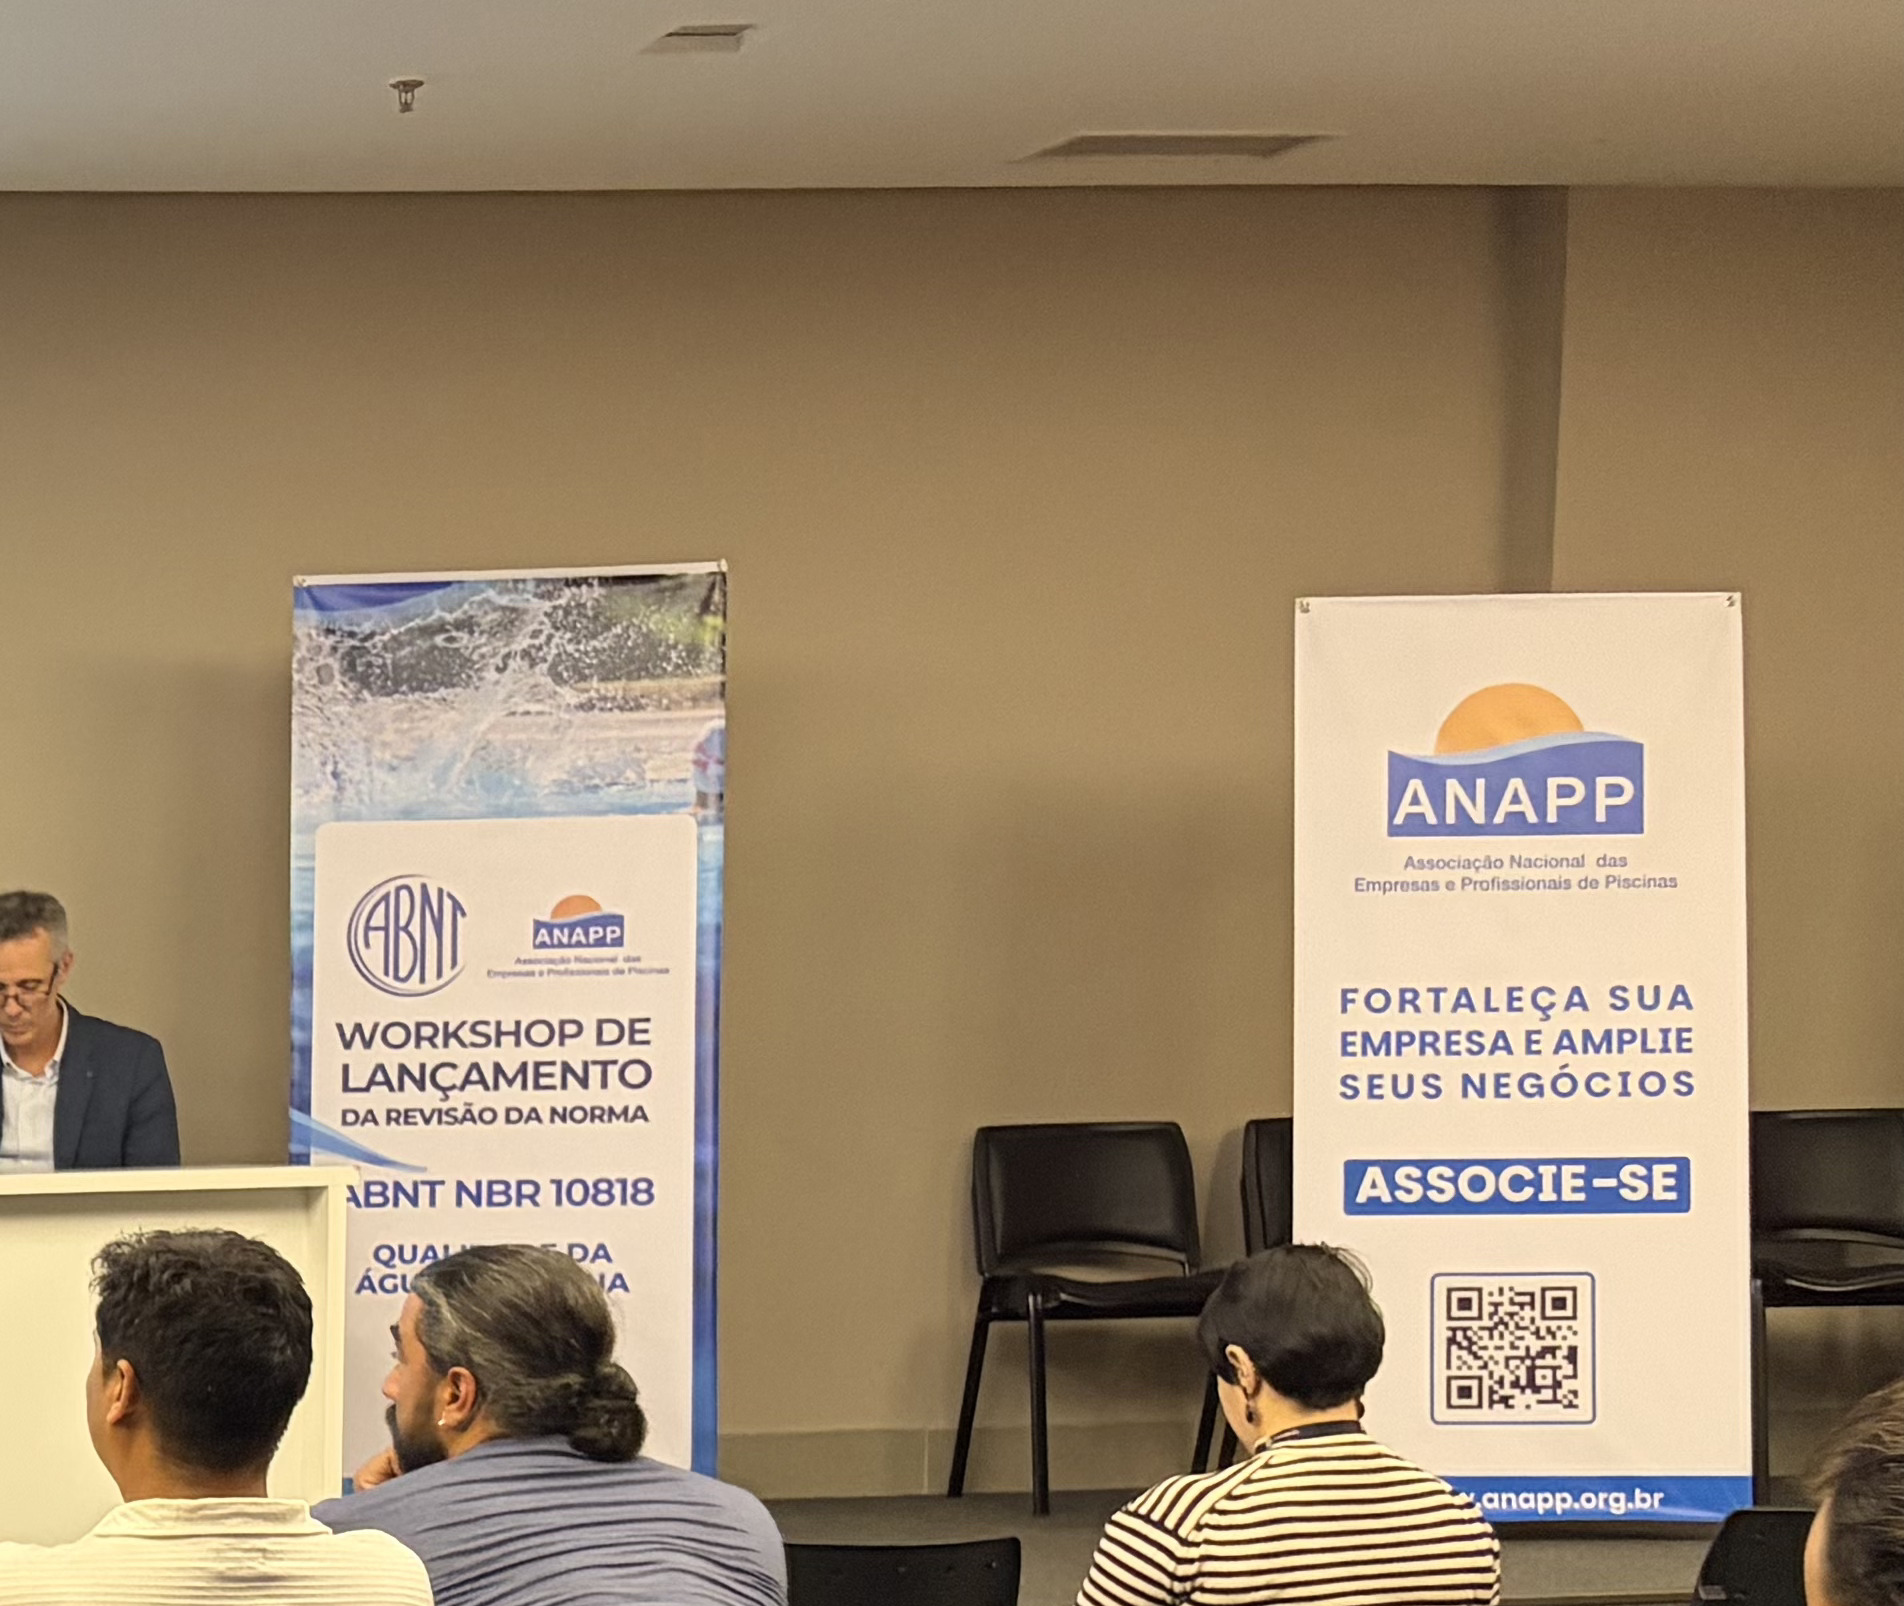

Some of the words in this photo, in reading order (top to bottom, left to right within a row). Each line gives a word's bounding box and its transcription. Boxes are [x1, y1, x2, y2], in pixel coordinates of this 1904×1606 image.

[1393, 776, 1635, 825] ANAPP
[1403, 855, 1504, 873] Associação
[1509, 853, 1585, 869] Nacional
[1596, 853, 1628, 868] das
[1354, 877, 1440, 896] Empresas
[1445, 880, 1456, 892] e
[1461, 875, 1572, 892] Profissionais
[1577, 875, 1600, 890] de
[1605, 874, 1678, 889] Piscinas
[364, 882, 467, 984] ABNT
[535, 926, 621, 946] ANAPP
[1341, 986, 1590, 1022] FORTALEÇA
[1609, 984, 1694, 1011] SUA
[335, 1019, 584, 1050] WORKSHOP
[596, 1017, 651, 1046] DE
[1341, 1030, 1514, 1057] EMPRESA
[1525, 1029, 1542, 1055] E
[1552, 1027, 1693, 1055] AMPLIE
[342, 1059, 652, 1102] LANÇAMENTO
[1339, 1073, 1442, 1100] SEUS
[1461, 1063, 1694, 1099] NEGÓCIOS
[341, 1108, 380, 1127] DA
[385, 1102, 498, 1126] REVISÃO
[505, 1106, 543, 1125] DA
[549, 1105, 650, 1124] NORMA
[455, 1179, 541, 1208] NBR
[549, 1177, 655, 1207] 10818
[1355, 1163, 1678, 1203] ASSOCIE-SE
[567, 1243, 613, 1263] DA
[355, 1268, 411, 1294] ÁG
[1471, 1488, 1665, 1515] .anapp.org.br
